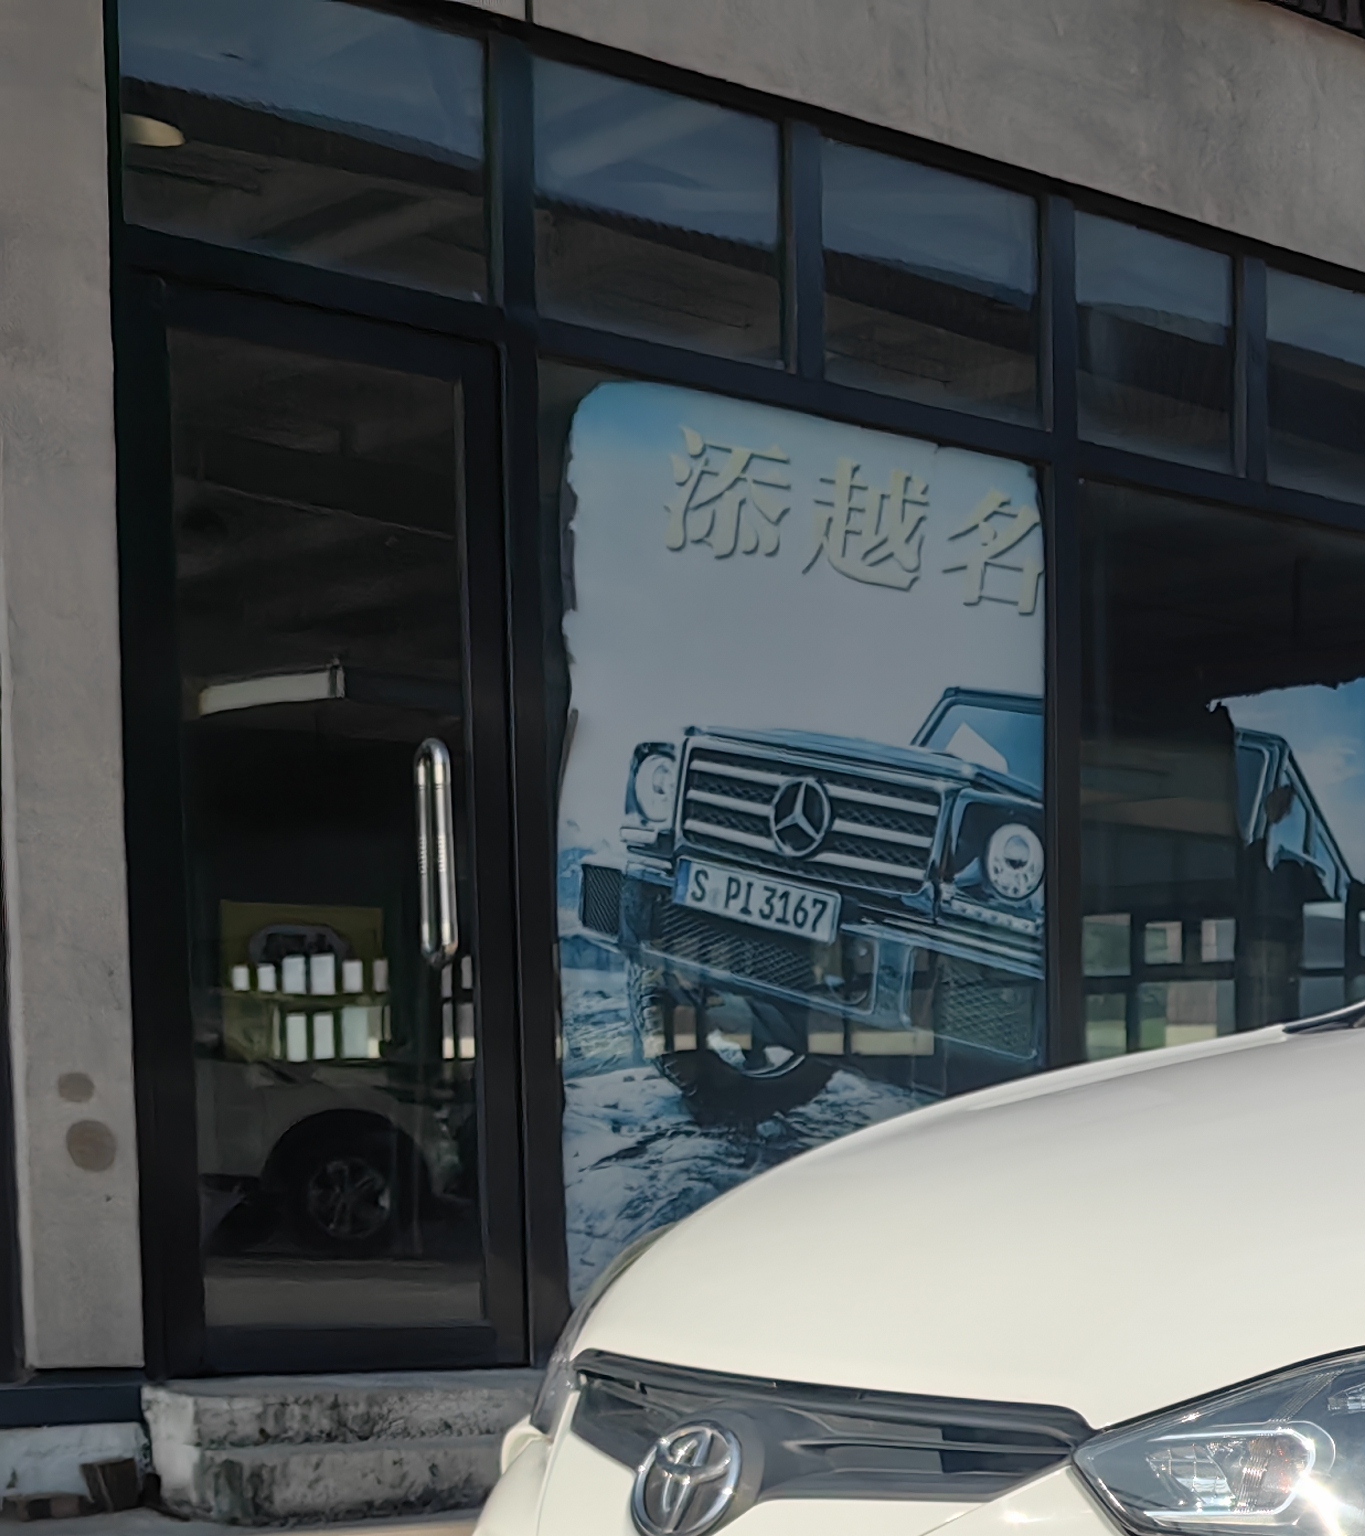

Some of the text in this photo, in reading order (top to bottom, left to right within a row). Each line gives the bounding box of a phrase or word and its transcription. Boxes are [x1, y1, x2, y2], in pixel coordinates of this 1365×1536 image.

[663, 424, 1046, 617] 添越名
[689, 868, 710, 902] S
